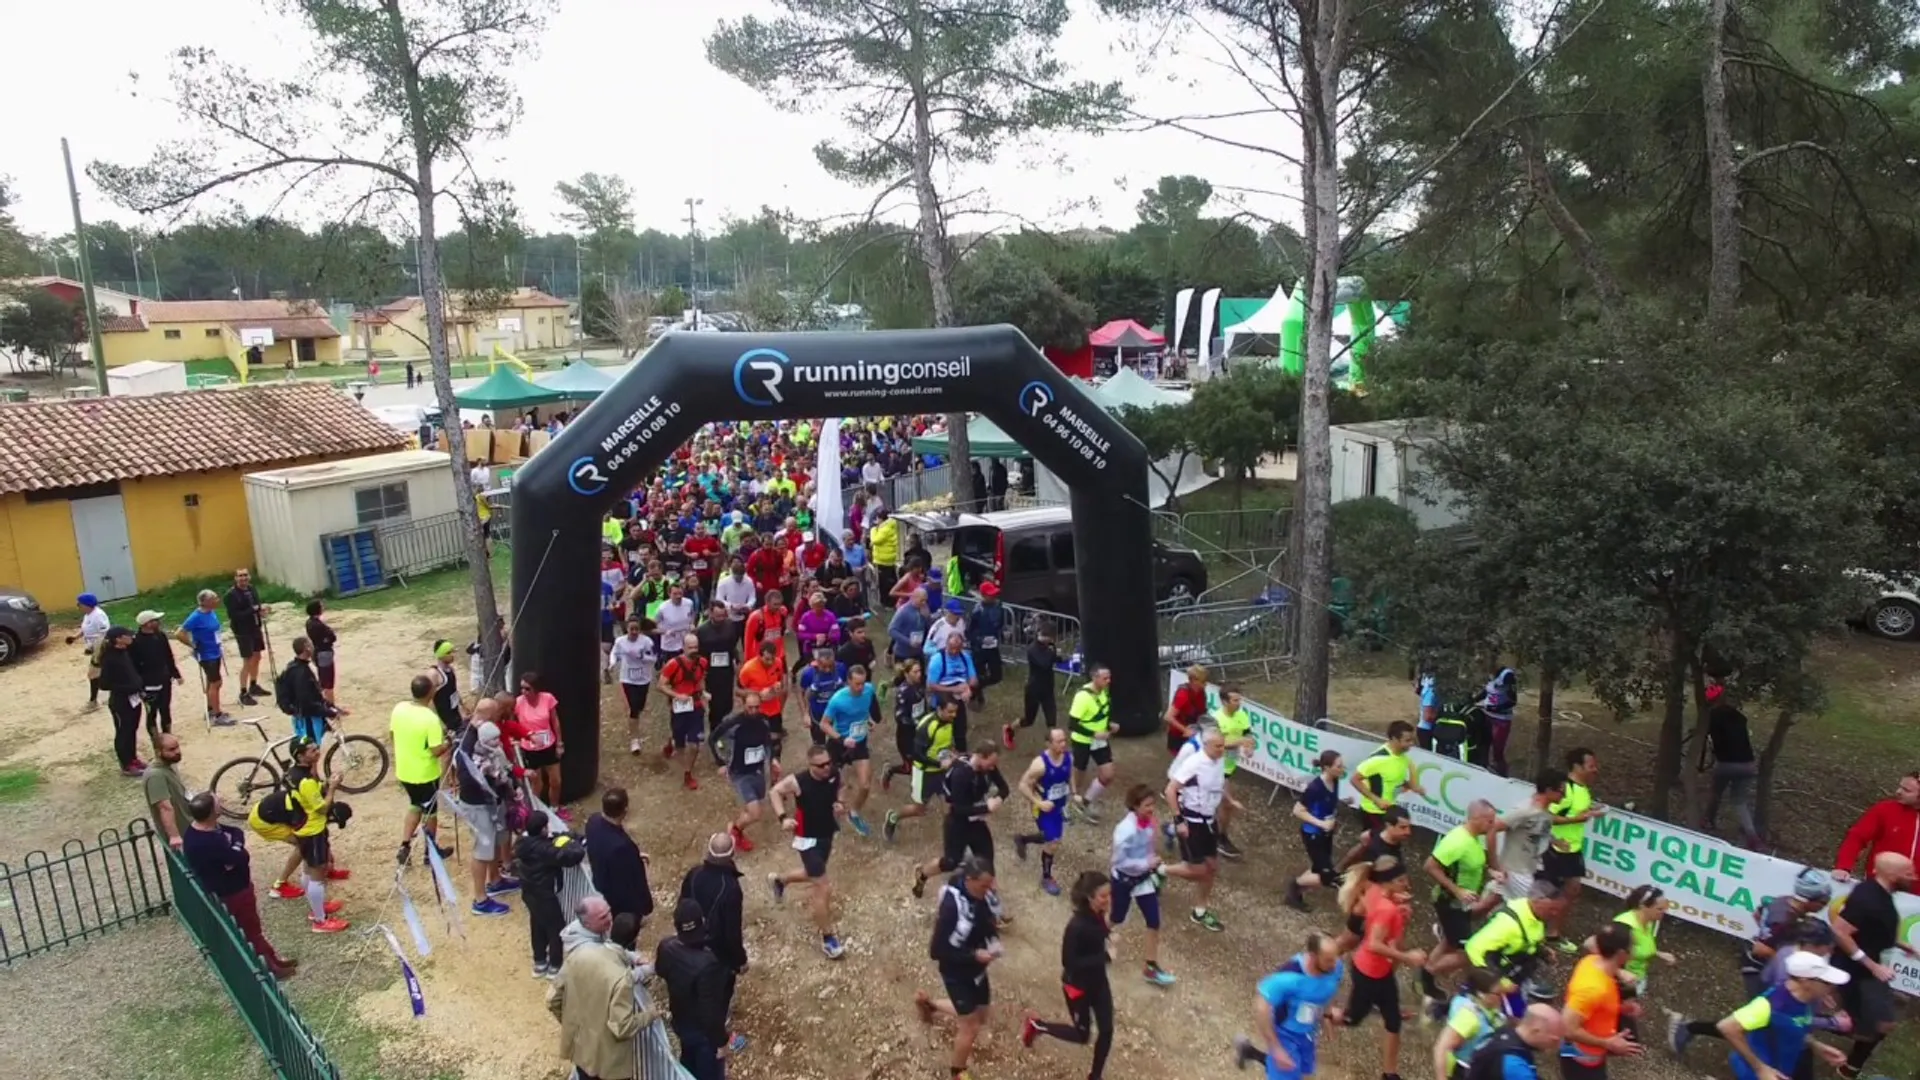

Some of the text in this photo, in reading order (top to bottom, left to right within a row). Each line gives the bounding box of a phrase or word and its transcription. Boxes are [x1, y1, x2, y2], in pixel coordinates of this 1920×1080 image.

[793, 356, 970, 385] runningconseil
[824, 386, 943, 398] www.running-conseil.com
[601, 395, 662, 452] MARSEILLE
[607, 402, 681, 471] 04 96 10 08 10
[1042, 414, 1107, 469] 04 96 10 08 10
[1059, 405, 1111, 453] MARSEILLE
